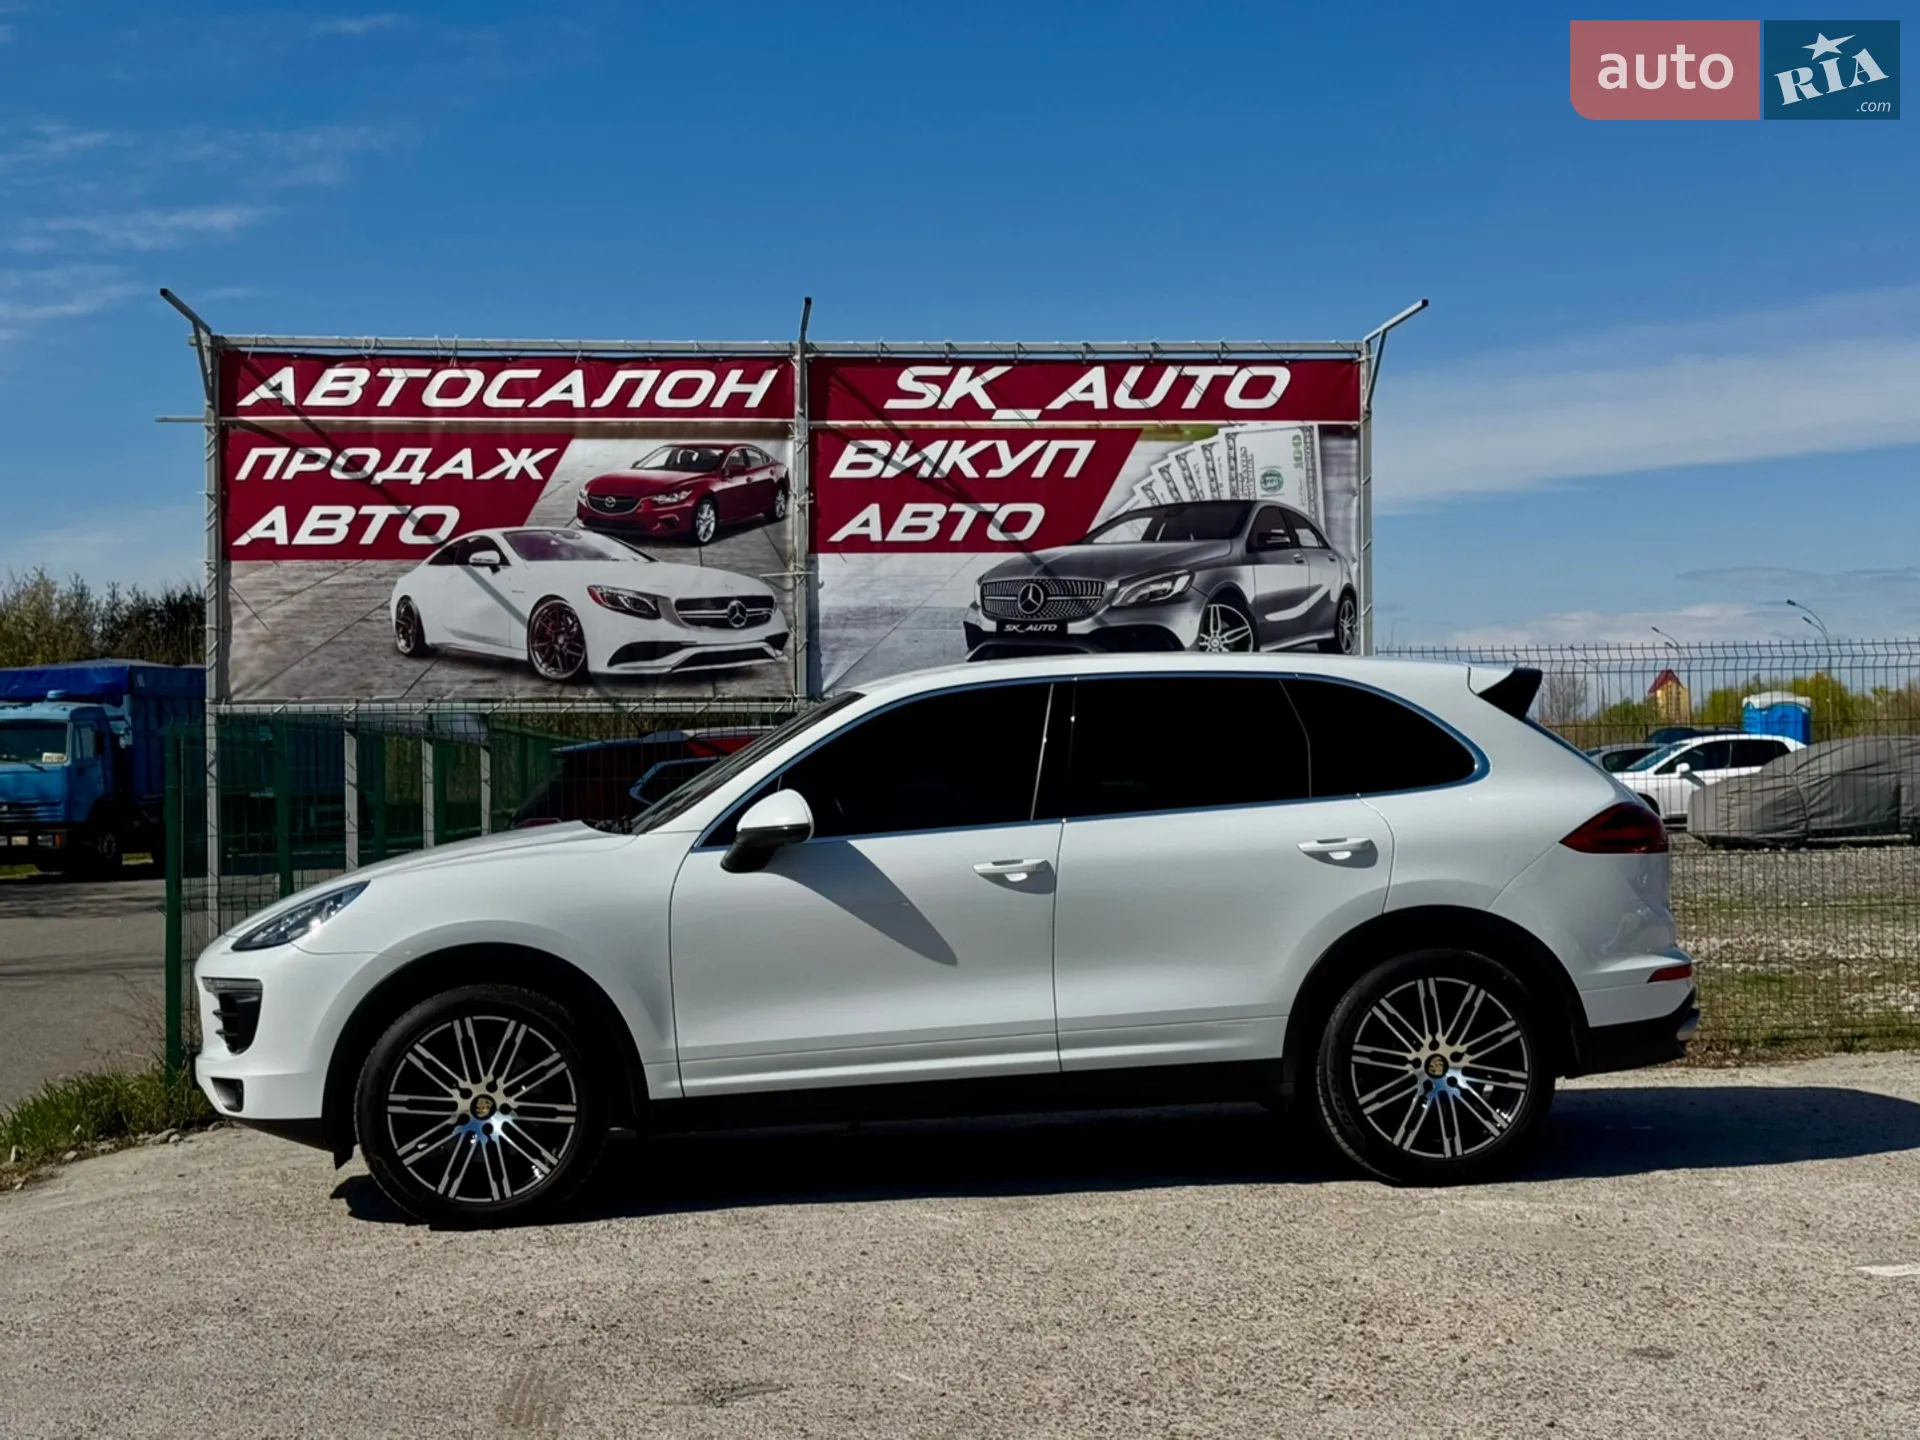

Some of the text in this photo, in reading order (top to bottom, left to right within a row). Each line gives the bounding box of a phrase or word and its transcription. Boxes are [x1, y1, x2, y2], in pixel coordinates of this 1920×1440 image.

[236, 366, 779, 408] АВТОСАЛОН
[883, 366, 1291, 420] SK_AUTO
[235, 447, 559, 485] ПРОДАЖ
[829, 440, 1097, 478] ВИКУП
[1292, 434, 1304, 470] 100
[232, 505, 460, 545] АВТО
[827, 503, 1046, 542] АВТО
[1003, 623, 1058, 633] SK_AUTO
